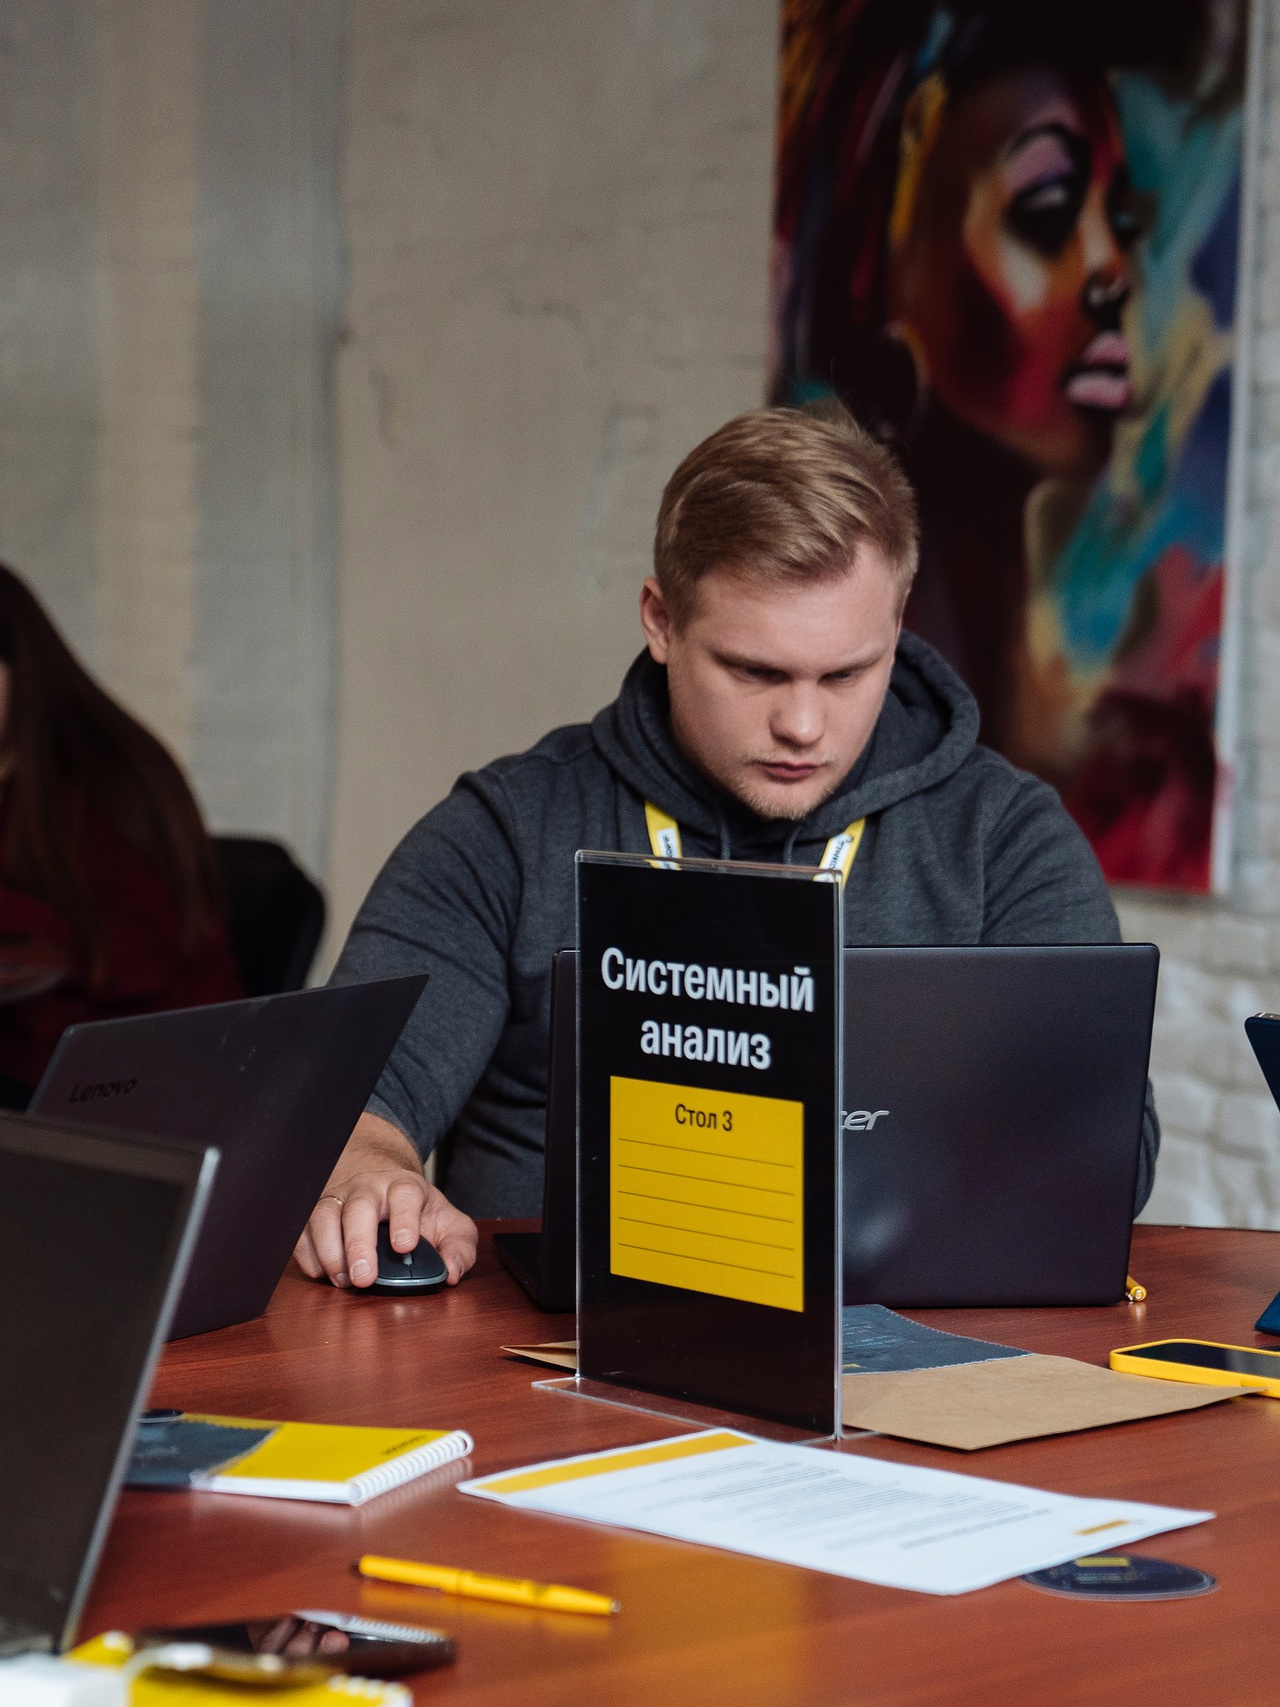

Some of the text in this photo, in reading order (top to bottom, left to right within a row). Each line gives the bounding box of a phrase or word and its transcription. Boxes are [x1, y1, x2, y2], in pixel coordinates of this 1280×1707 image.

[601, 947, 814, 1013] Системный
[640, 1020, 771, 1070] анализ
[70, 1078, 137, 1103] Lenovo
[675, 1104, 733, 1132] Стол 3
